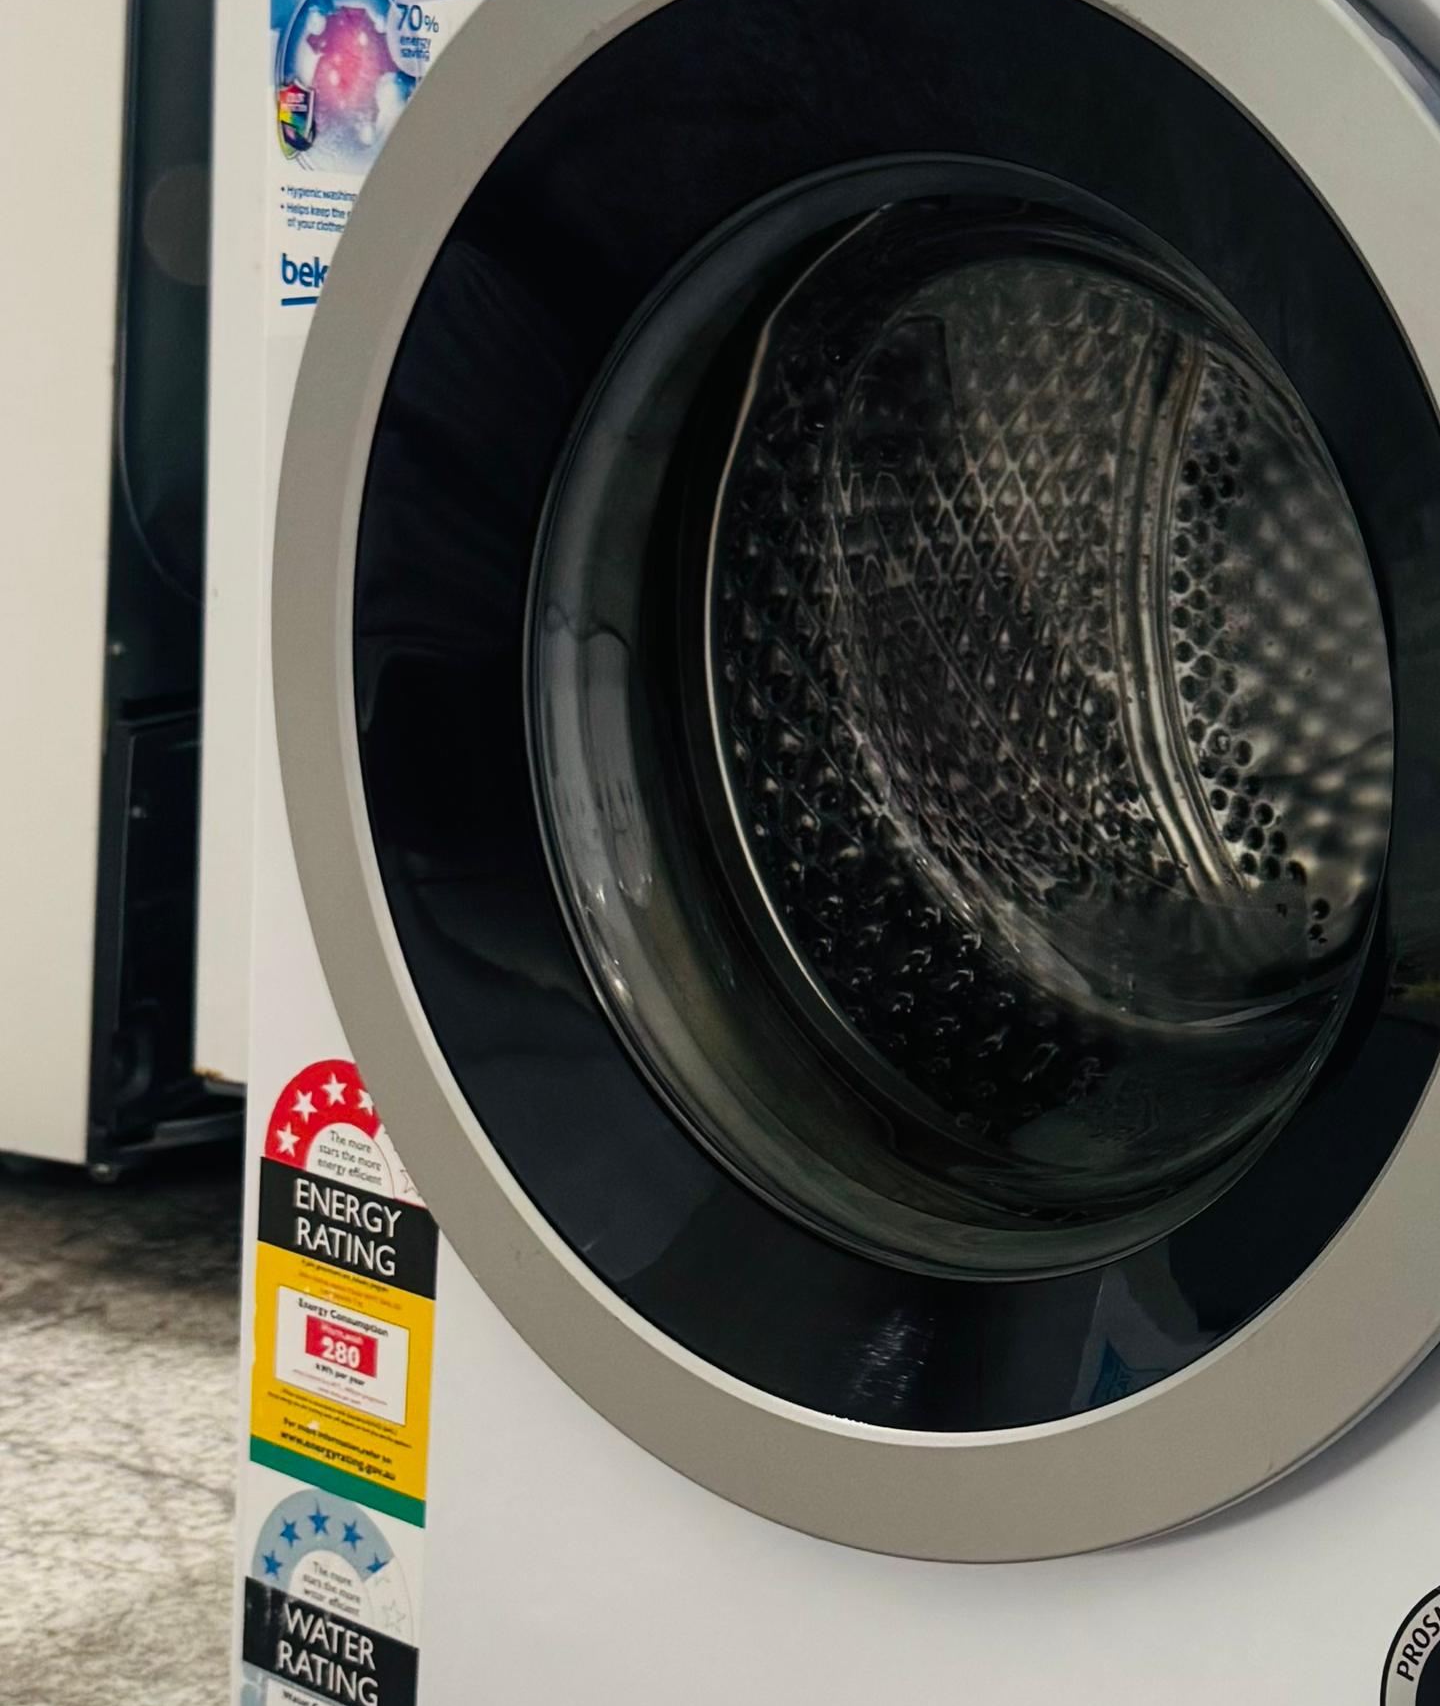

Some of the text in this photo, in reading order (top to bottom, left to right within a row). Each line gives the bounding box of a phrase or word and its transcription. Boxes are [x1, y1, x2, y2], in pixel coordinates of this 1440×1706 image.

[281, 252, 330, 289] bek
[319, 1144, 382, 1172] stars the more
[329, 1129, 372, 1154] The more
[317, 1158, 383, 1186] energy efficient
[294, 1178, 402, 1238] ENERGY
[296, 1216, 396, 1277] RATING
[298, 1297, 329, 1317] Energy
[330, 1309, 389, 1339] Consumption
[321, 1335, 361, 1370] 280
[312, 1560, 329, 1575] The
[284, 1602, 376, 1671] WATER
